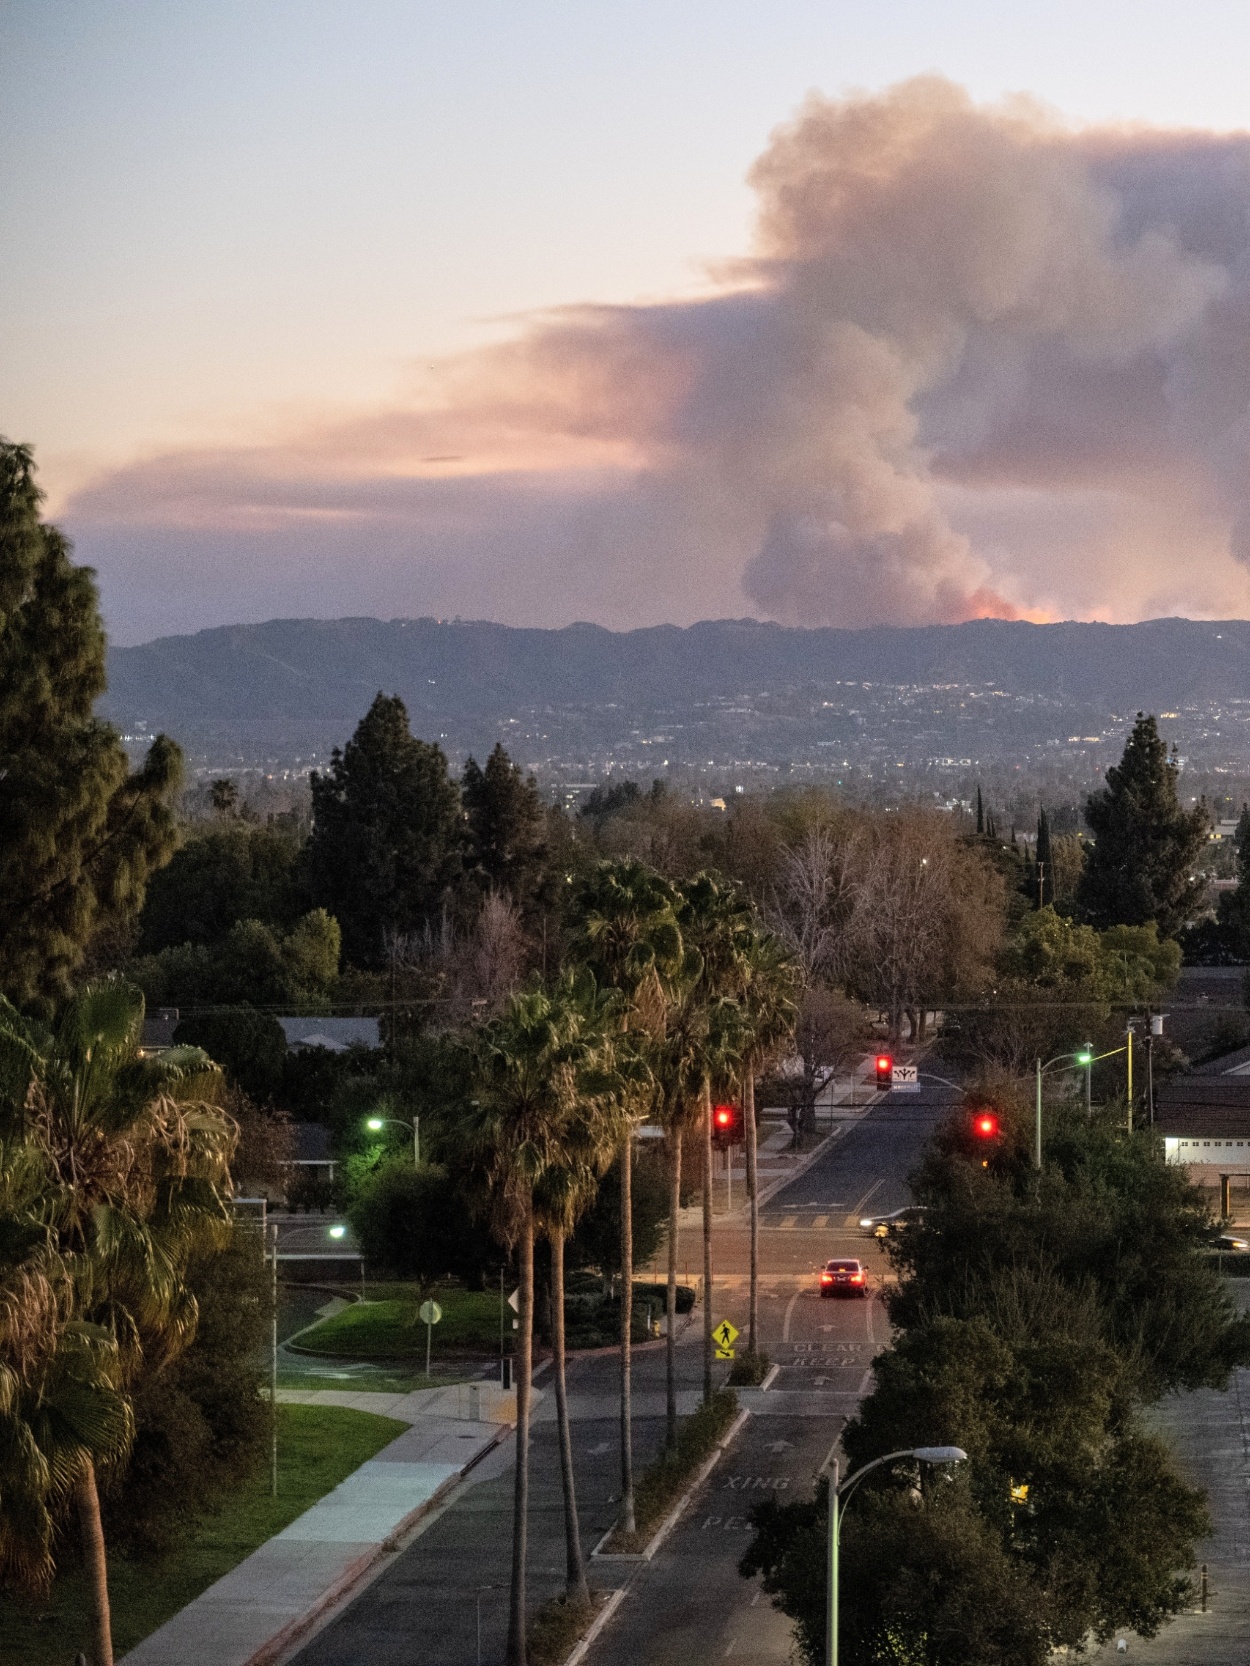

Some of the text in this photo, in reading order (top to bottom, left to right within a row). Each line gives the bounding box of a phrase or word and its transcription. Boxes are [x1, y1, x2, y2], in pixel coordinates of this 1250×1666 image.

[793, 1343, 862, 1352] CLEAR
[792, 1357, 856, 1366] KEEP
[722, 1476, 790, 1490] XING
